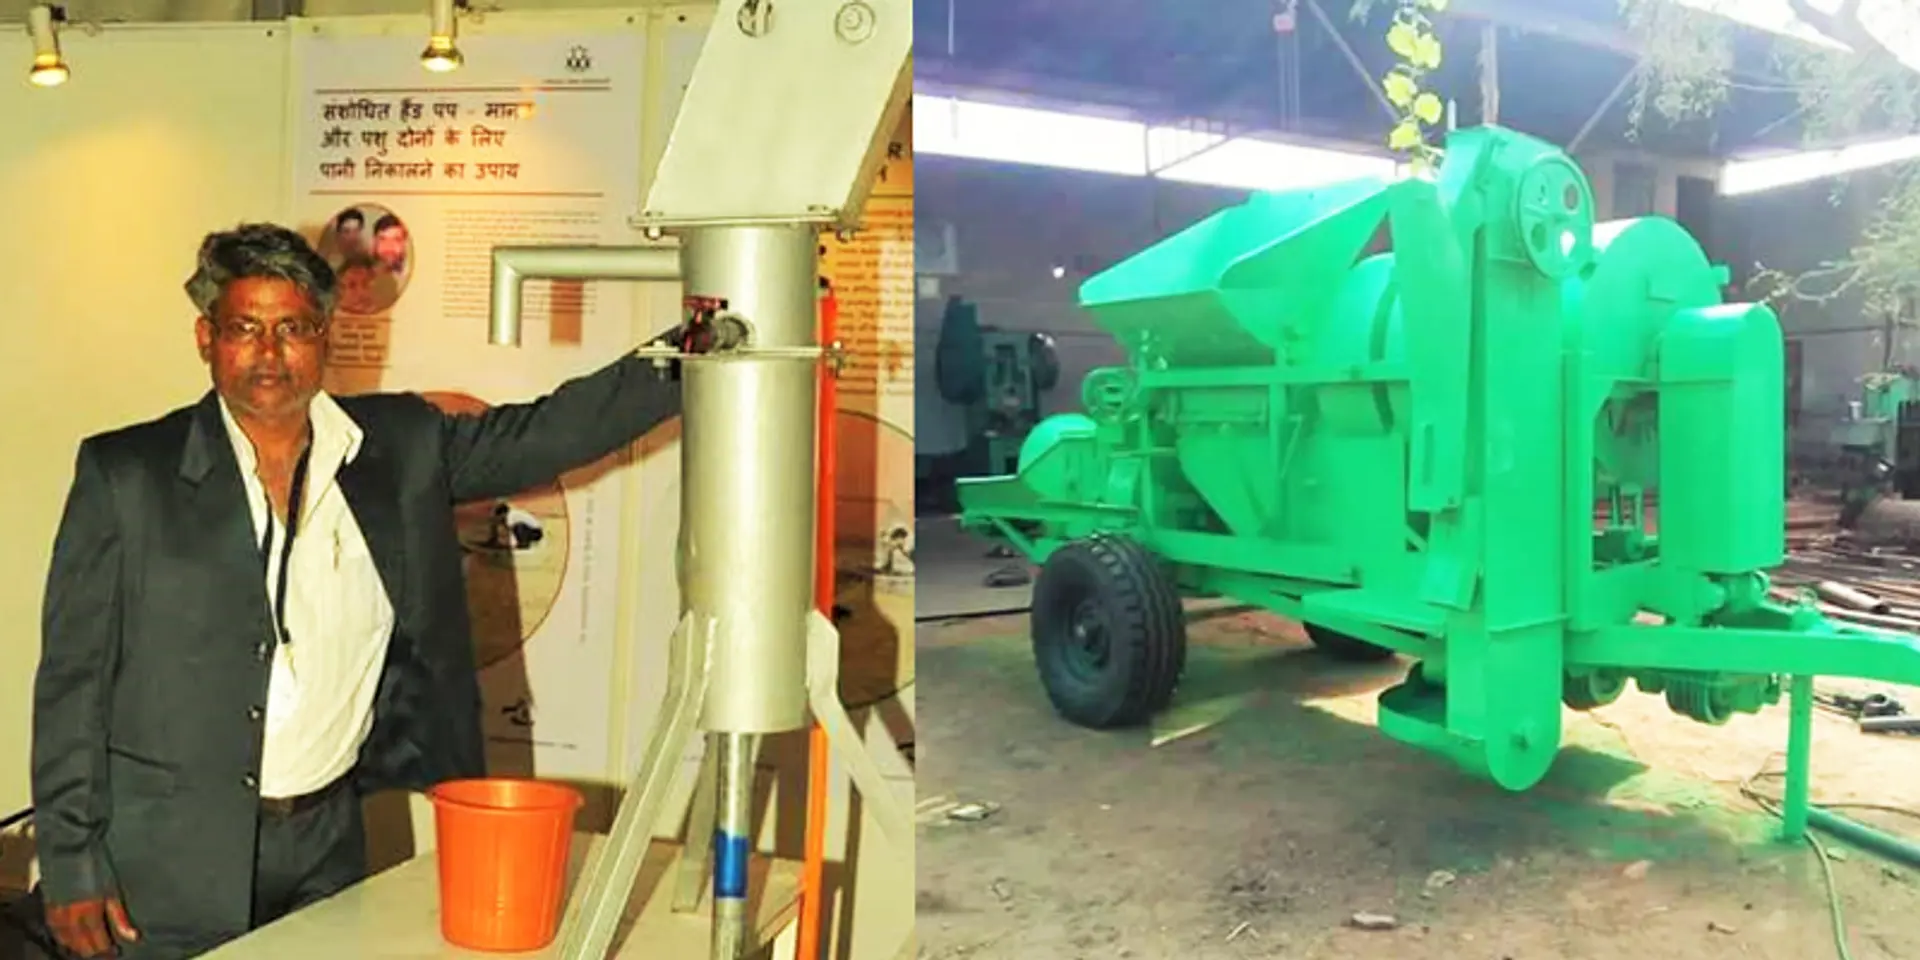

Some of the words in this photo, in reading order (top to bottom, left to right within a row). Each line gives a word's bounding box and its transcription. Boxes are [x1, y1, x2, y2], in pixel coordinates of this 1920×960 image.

[321, 126, 352, 148] और
[361, 130, 388, 156] पशु
[444, 127, 464, 146] के
[471, 124, 506, 148] लिए
[320, 157, 355, 180] पानी
[364, 156, 434, 180] निकालने
[444, 162, 466, 180] का
[475, 162, 520, 180] उपाय
